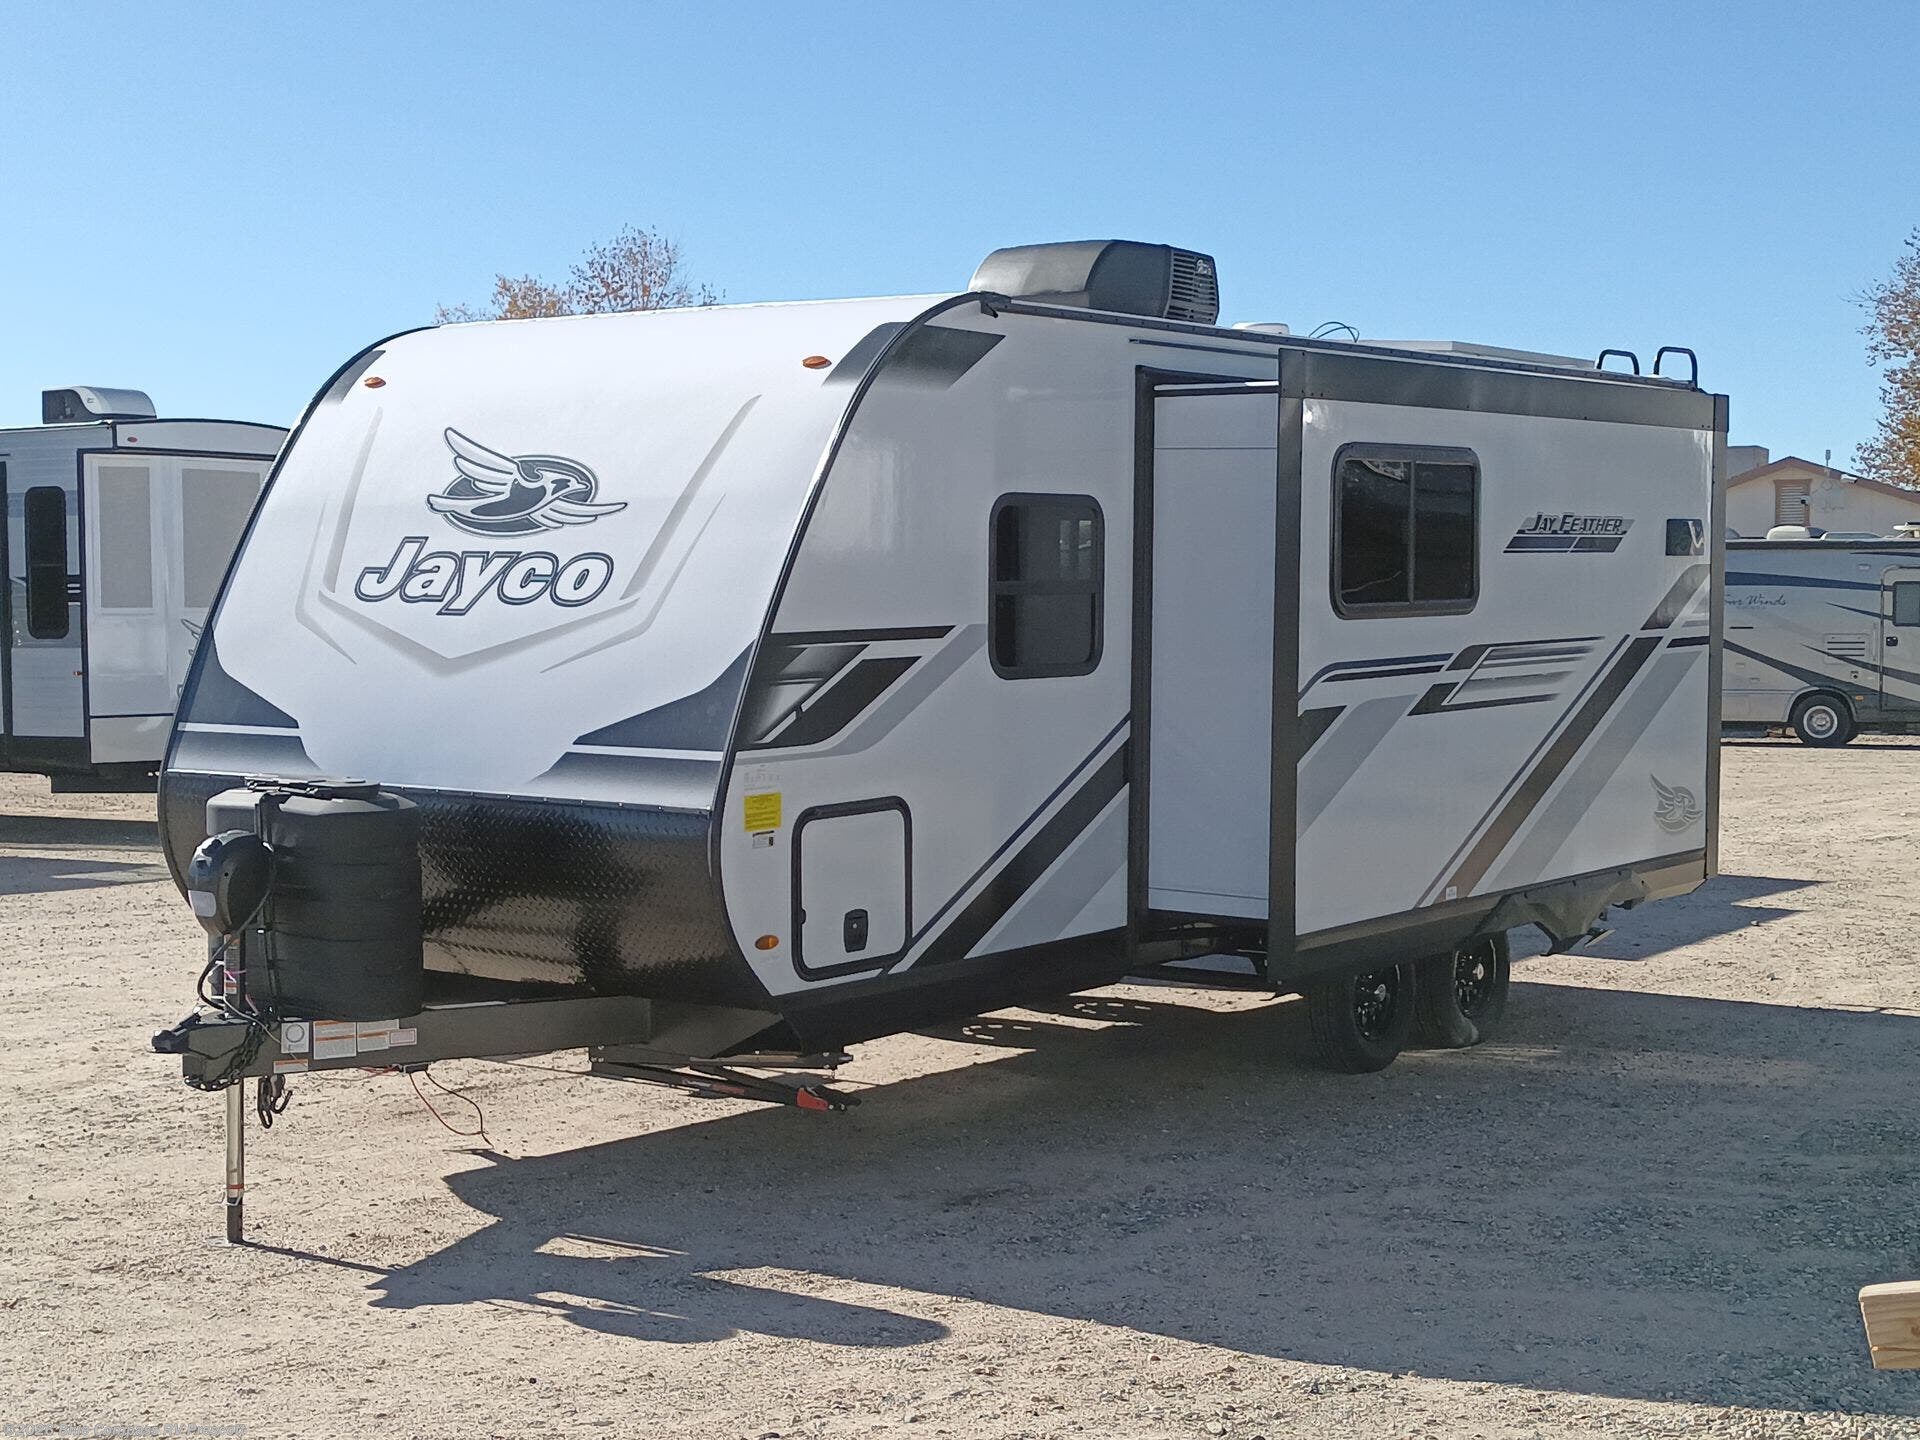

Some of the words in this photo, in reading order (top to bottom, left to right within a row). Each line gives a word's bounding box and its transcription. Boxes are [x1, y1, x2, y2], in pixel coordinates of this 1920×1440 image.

[1526, 513, 1557, 533] JAY
[1559, 513, 1624, 534] FEATHER
[354, 536, 614, 617] Jayco
